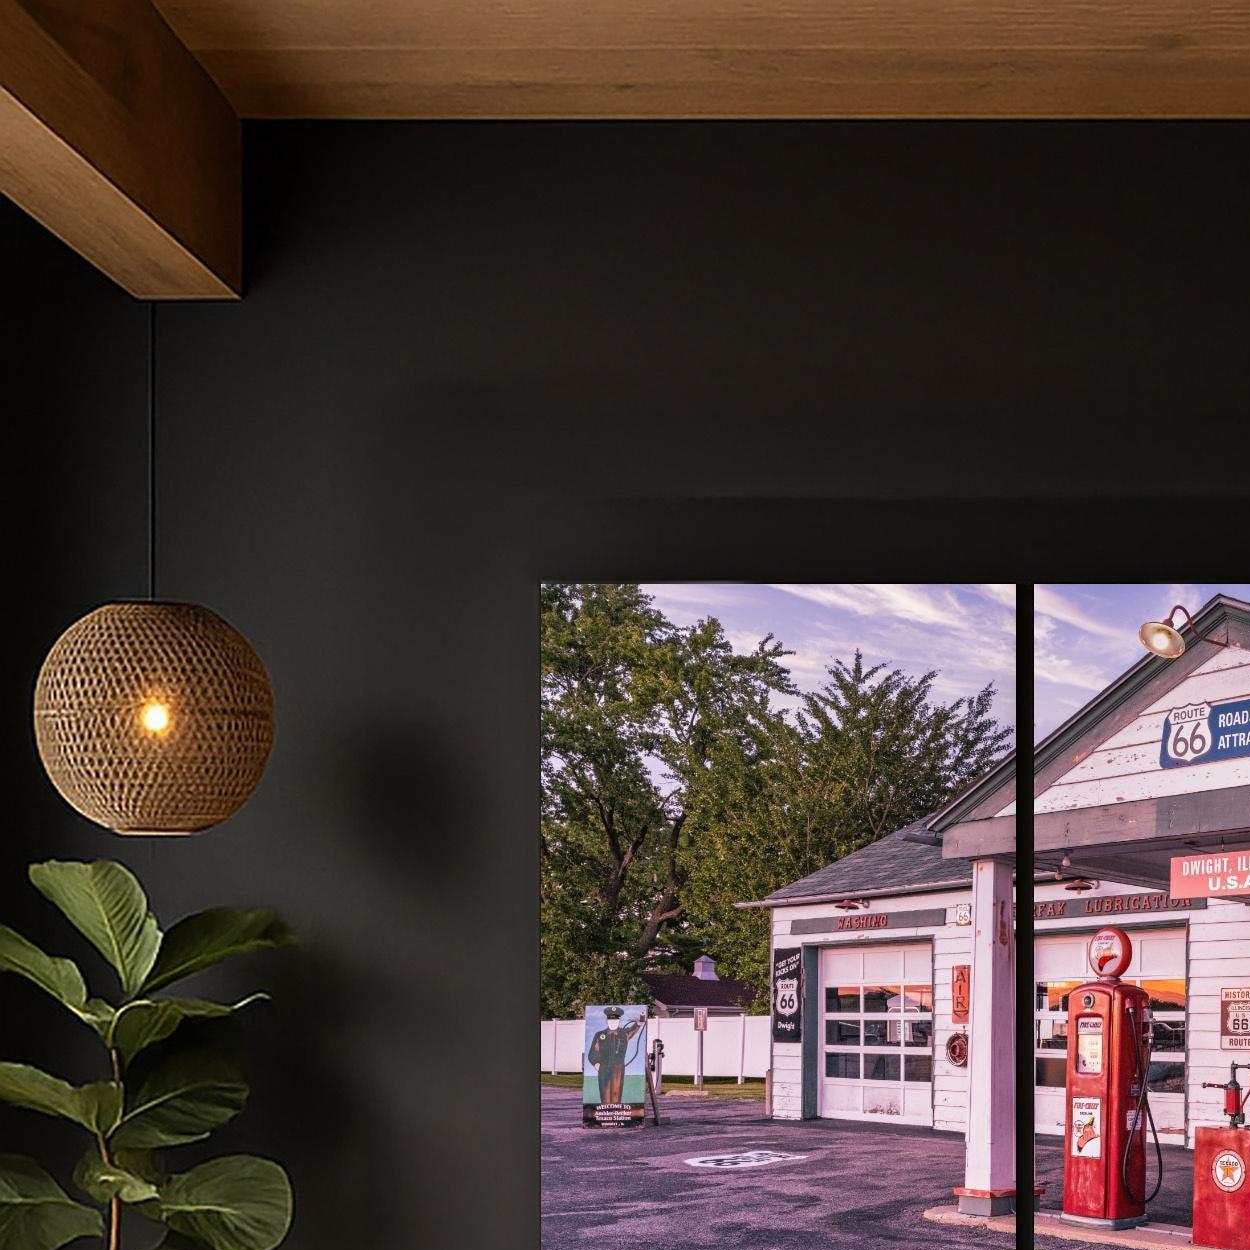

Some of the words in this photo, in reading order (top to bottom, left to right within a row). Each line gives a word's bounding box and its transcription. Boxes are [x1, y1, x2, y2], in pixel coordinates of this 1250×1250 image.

[1173, 707, 1205, 721] ROUTE
[1173, 722, 1206, 757] 66
[1182, 857, 1232, 874] DWIGHT,
[1034, 902, 1066, 917] FAX
[1085, 894, 1192, 913] LUBRICATION
[837, 913, 888, 929] WASHING
[959, 911, 969, 921] 66
[955, 970, 966, 1009] AIR
[780, 994, 794, 1009] 66
[778, 1021, 795, 1031] Dwight
[1233, 1019, 1249, 1030] 66
